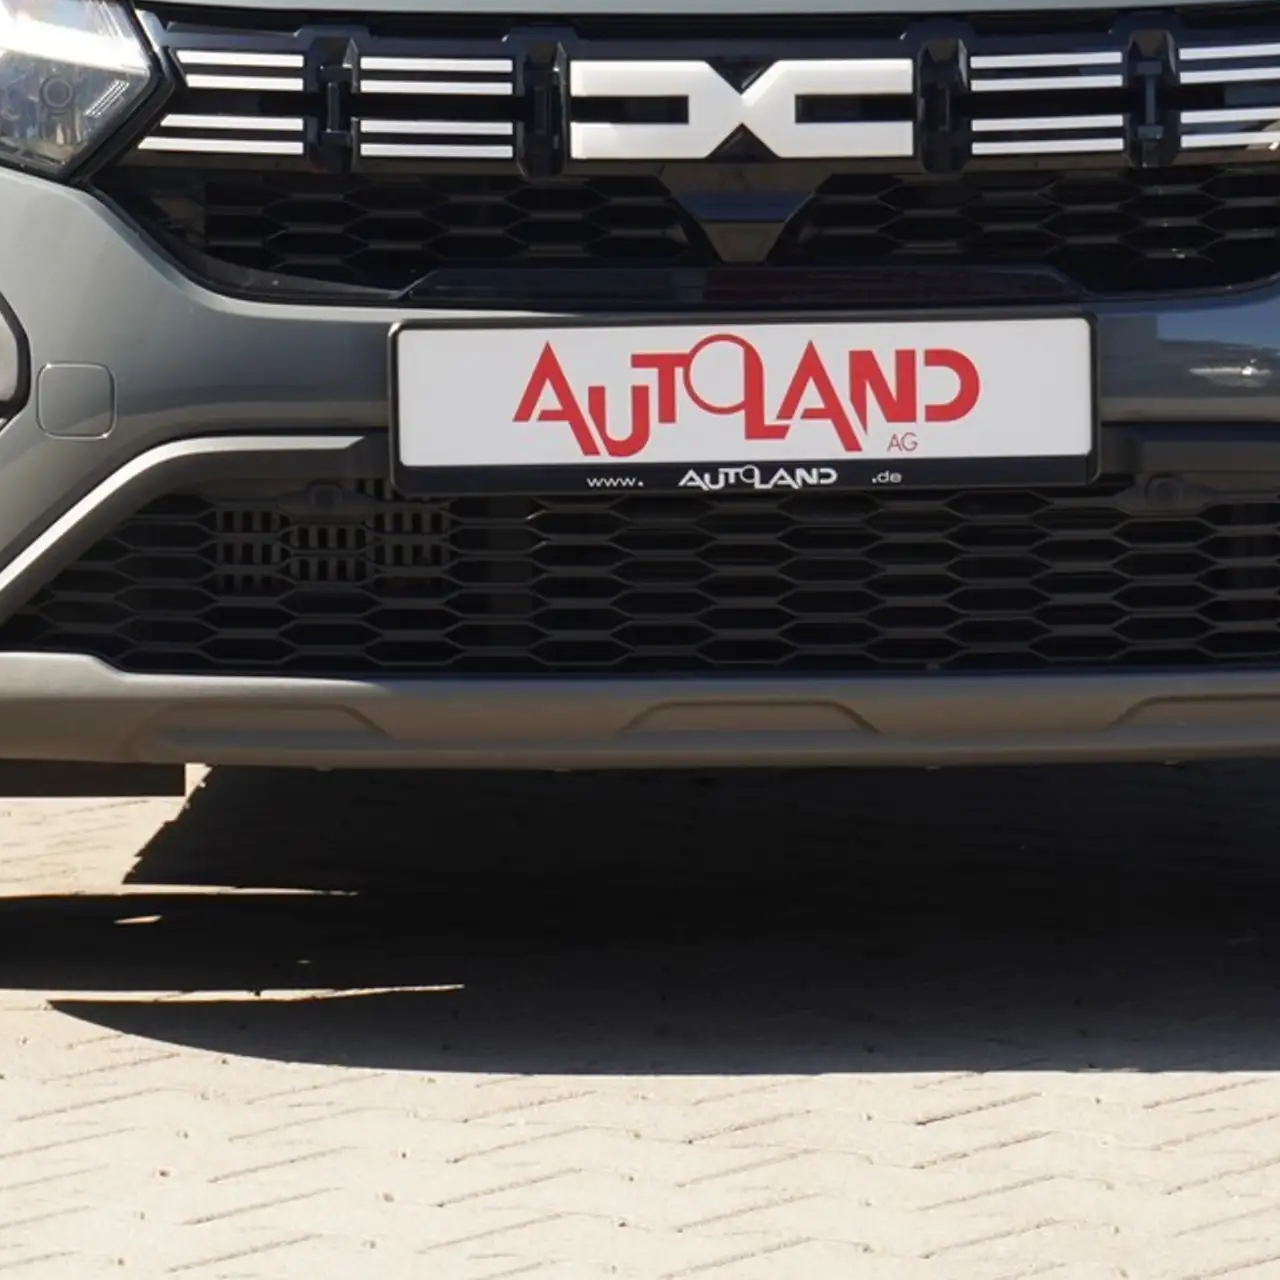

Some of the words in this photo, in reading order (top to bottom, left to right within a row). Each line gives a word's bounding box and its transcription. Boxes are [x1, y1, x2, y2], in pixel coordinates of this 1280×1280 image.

[512, 332, 982, 458] AUTOLAND
[886, 431, 919, 453] AG
[678, 464, 838, 491] AUTOLAND
